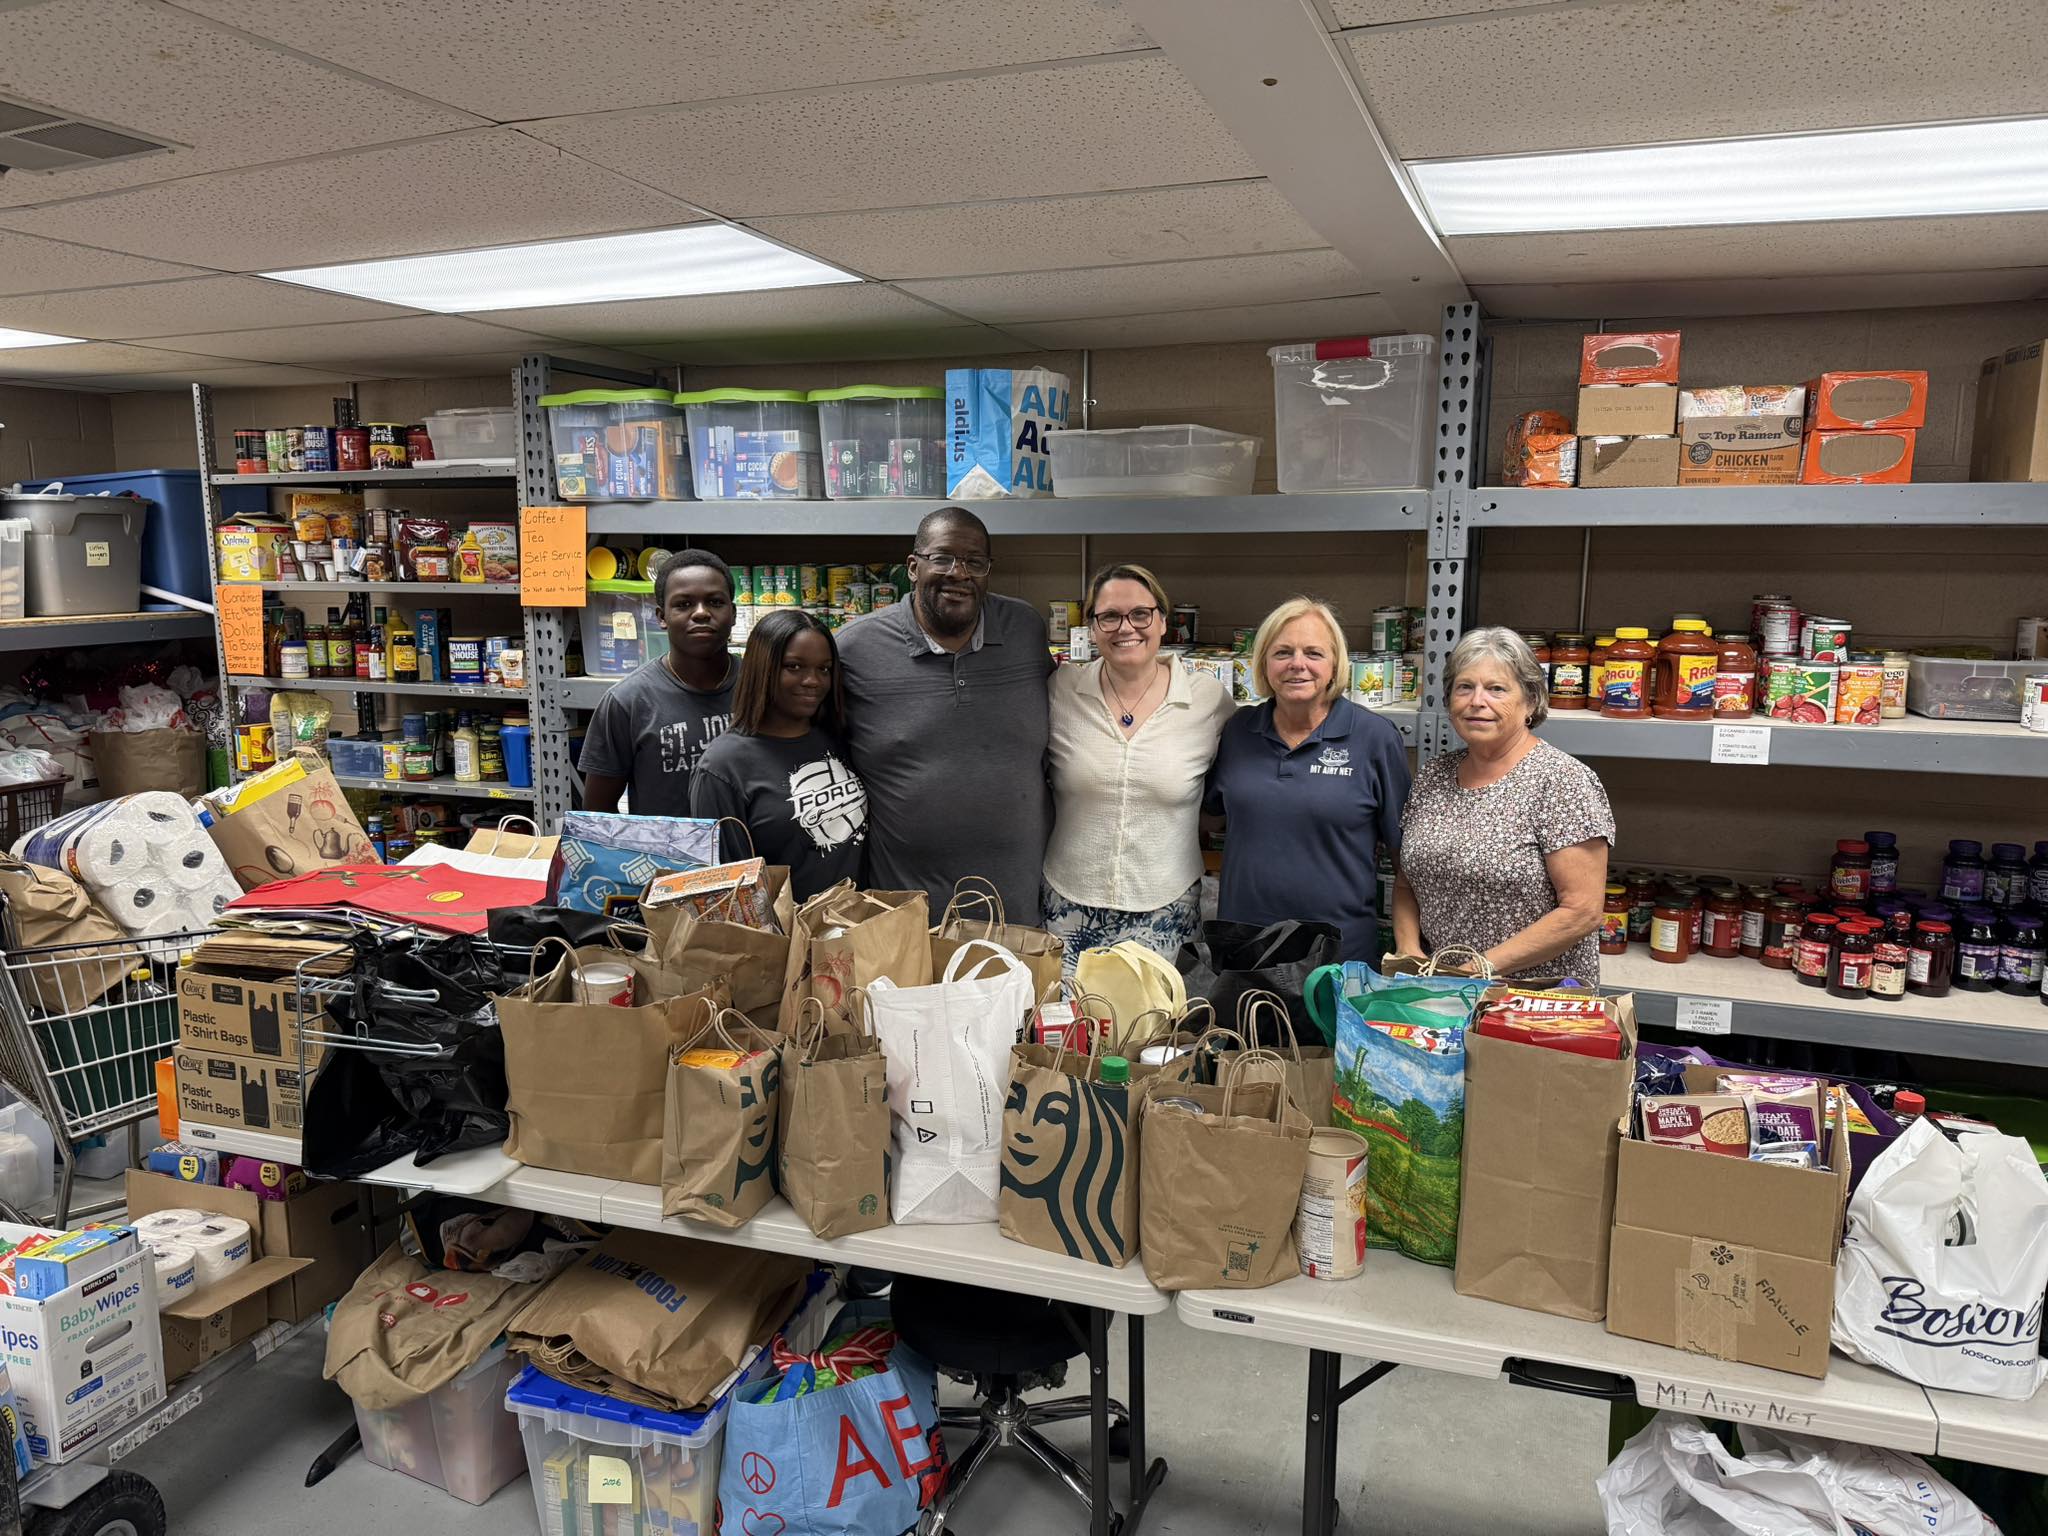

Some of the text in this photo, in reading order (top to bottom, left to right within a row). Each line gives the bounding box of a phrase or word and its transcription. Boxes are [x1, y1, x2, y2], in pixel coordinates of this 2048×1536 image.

[954, 398, 970, 463] aldi.us
[1713, 431, 1782, 442] Top Ramen
[1715, 455, 1769, 466] CHICKEN
[525, 510, 556, 524] Coffee
[222, 534, 250, 546] Splenda
[522, 530, 544, 542] Tea
[524, 550, 582, 563] Self Service
[523, 567, 546, 577] Cart
[455, 651, 479, 659] HOUSE
[1689, 666, 1716, 681] RAG
[660, 722, 696, 756] ST.
[1310, 765, 1354, 776] MT AIRY NET
[800, 779, 865, 811] FORCE
[183, 1009, 216, 1025] Plastic
[184, 1024, 248, 1046] T-Shirt Bags
[182, 1083, 212, 1098] Plastic
[183, 1097, 240, 1119] T-Shirt Bags
[1777, 1126, 1801, 1136] DATE
[183, 1159, 192, 1173] 18
[263, 1166, 272, 1179] 18
[83, 1271, 116, 1293] KIRKLAND
[96, 1282, 140, 1312] Wipes
[635, 1271, 688, 1313] FOOD
[67, 1302, 137, 1343] FRAGRANCE FREE
[2, 1325, 39, 1351] ipes
[7, 1354, 32, 1366] FREE
[1961, 1346, 2036, 1367] boscovs.com
[63, 1424, 97, 1449] KIRKLAND
[602, 1478, 621, 1487] 2026
